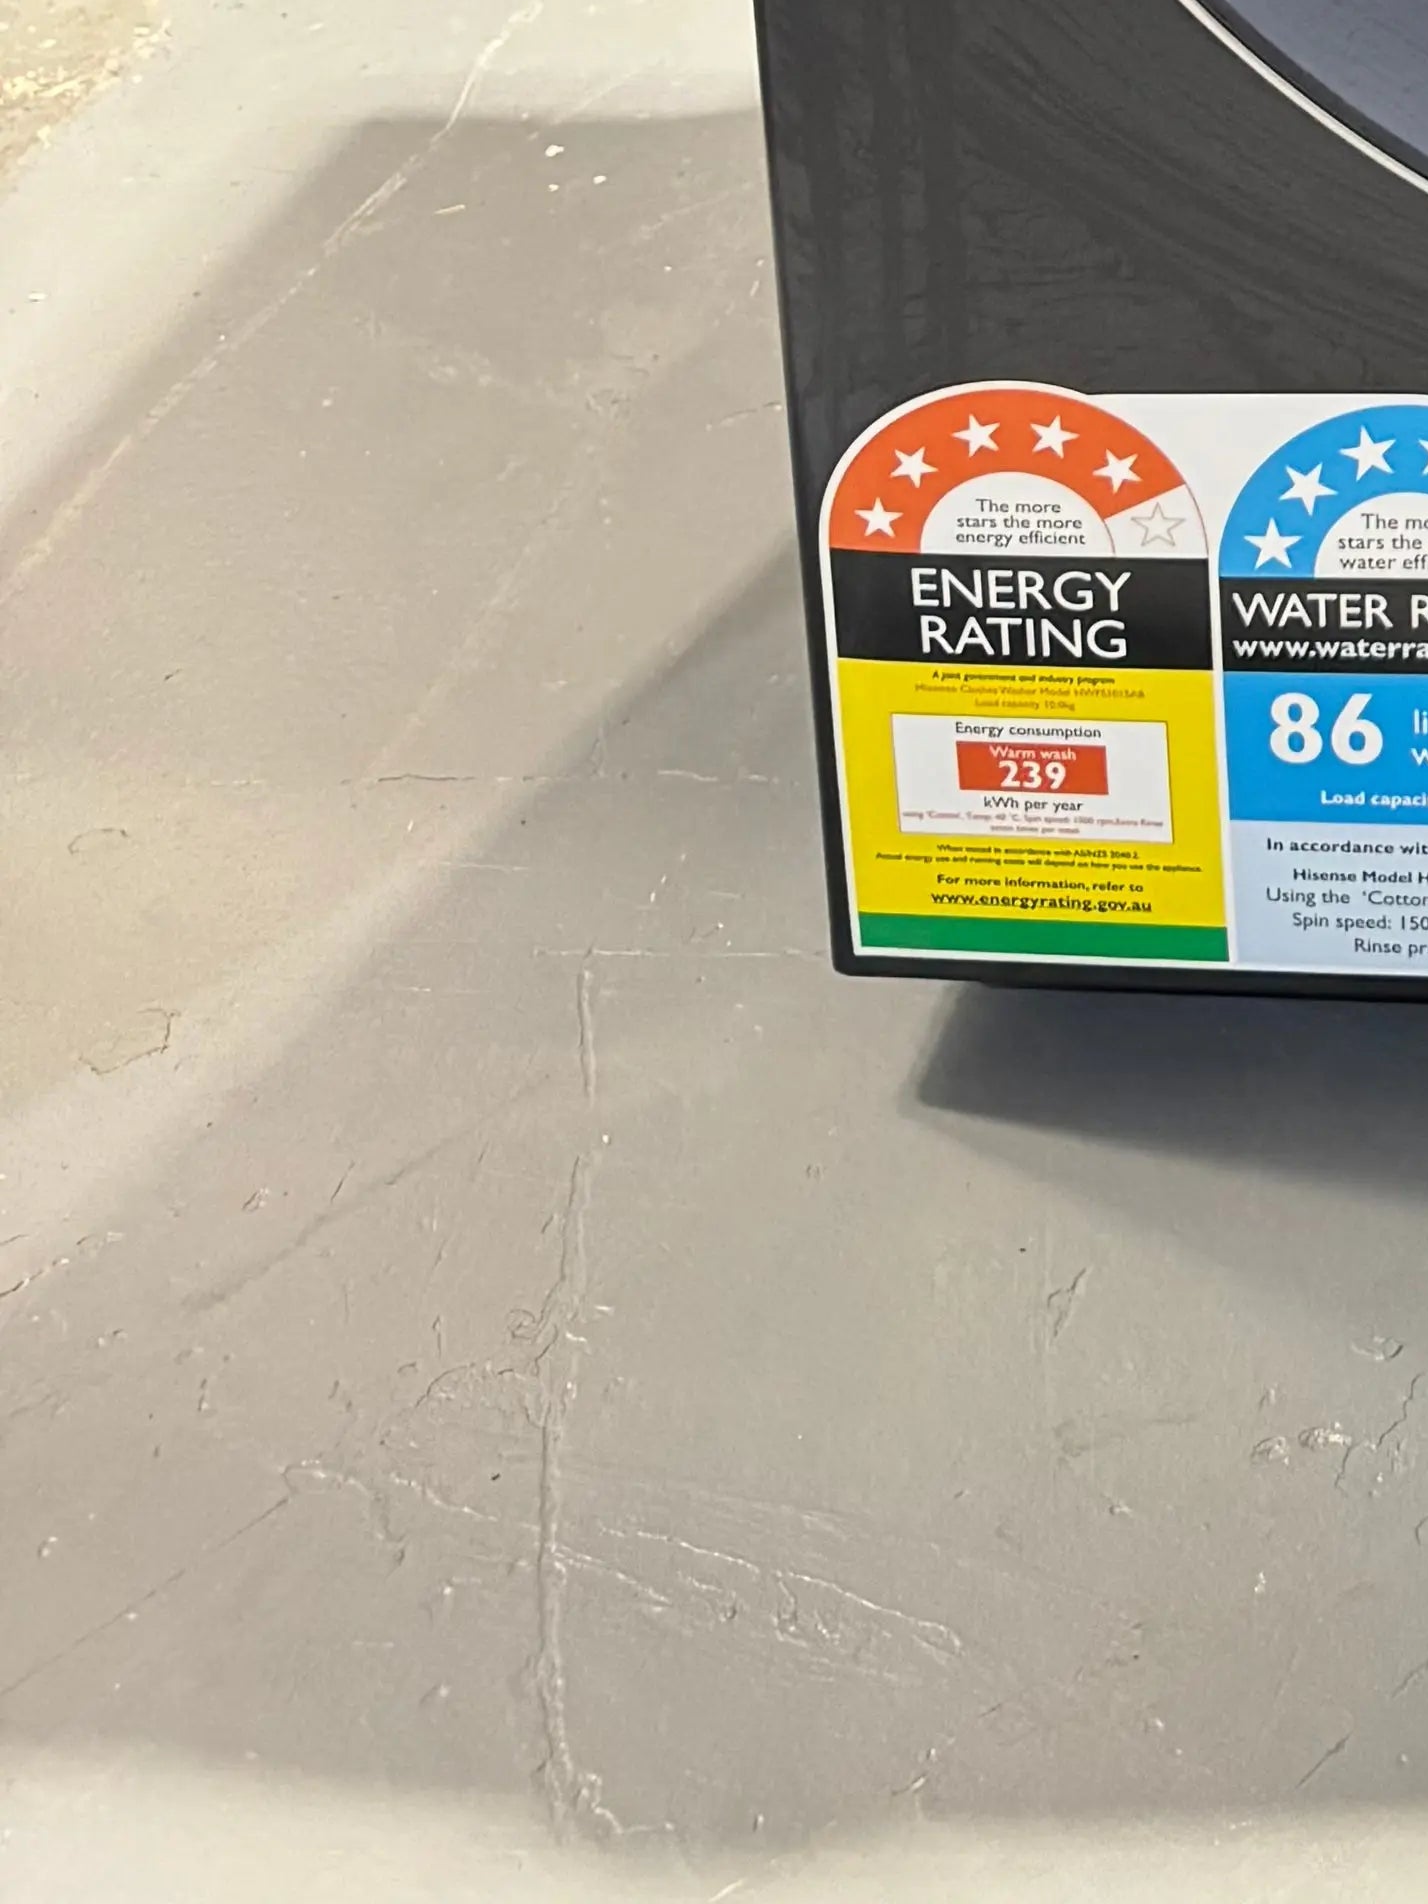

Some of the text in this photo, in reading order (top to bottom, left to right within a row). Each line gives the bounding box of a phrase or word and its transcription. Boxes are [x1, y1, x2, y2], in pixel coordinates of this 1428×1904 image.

[976, 499, 1061, 513] The more
[957, 517, 1082, 528] stars the more
[1361, 514, 1401, 530] The
[956, 533, 1085, 547] energy efficient
[1338, 537, 1385, 550] stars
[1392, 536, 1422, 550] the
[1339, 557, 1397, 570] water
[910, 567, 1132, 613] ENERGY
[1232, 592, 1394, 628] WATER
[920, 617, 1128, 660] RATING
[955, 721, 1101, 738] Energy consumption
[1269, 692, 1384, 765] 86
[989, 746, 1076, 760] Warm wash
[999, 762, 1066, 789] 239
[984, 797, 1083, 813] kWh per year
[1321, 790, 1364, 805] Load
[1267, 838, 1283, 852] In
[1290, 840, 1394, 854] accordance
[936, 875, 1143, 892] For more information, refer to
[1293, 869, 1357, 881] Hisense
[1362, 871, 1412, 883] Model
[931, 893, 1152, 912] www.energyrating.gov.au
[1266, 888, 1316, 906] Using
[1322, 890, 1350, 903] the
[1292, 912, 1329, 930] Spin
[1336, 915, 1391, 931] speed:
[1354, 938, 1401, 954] Rinse
